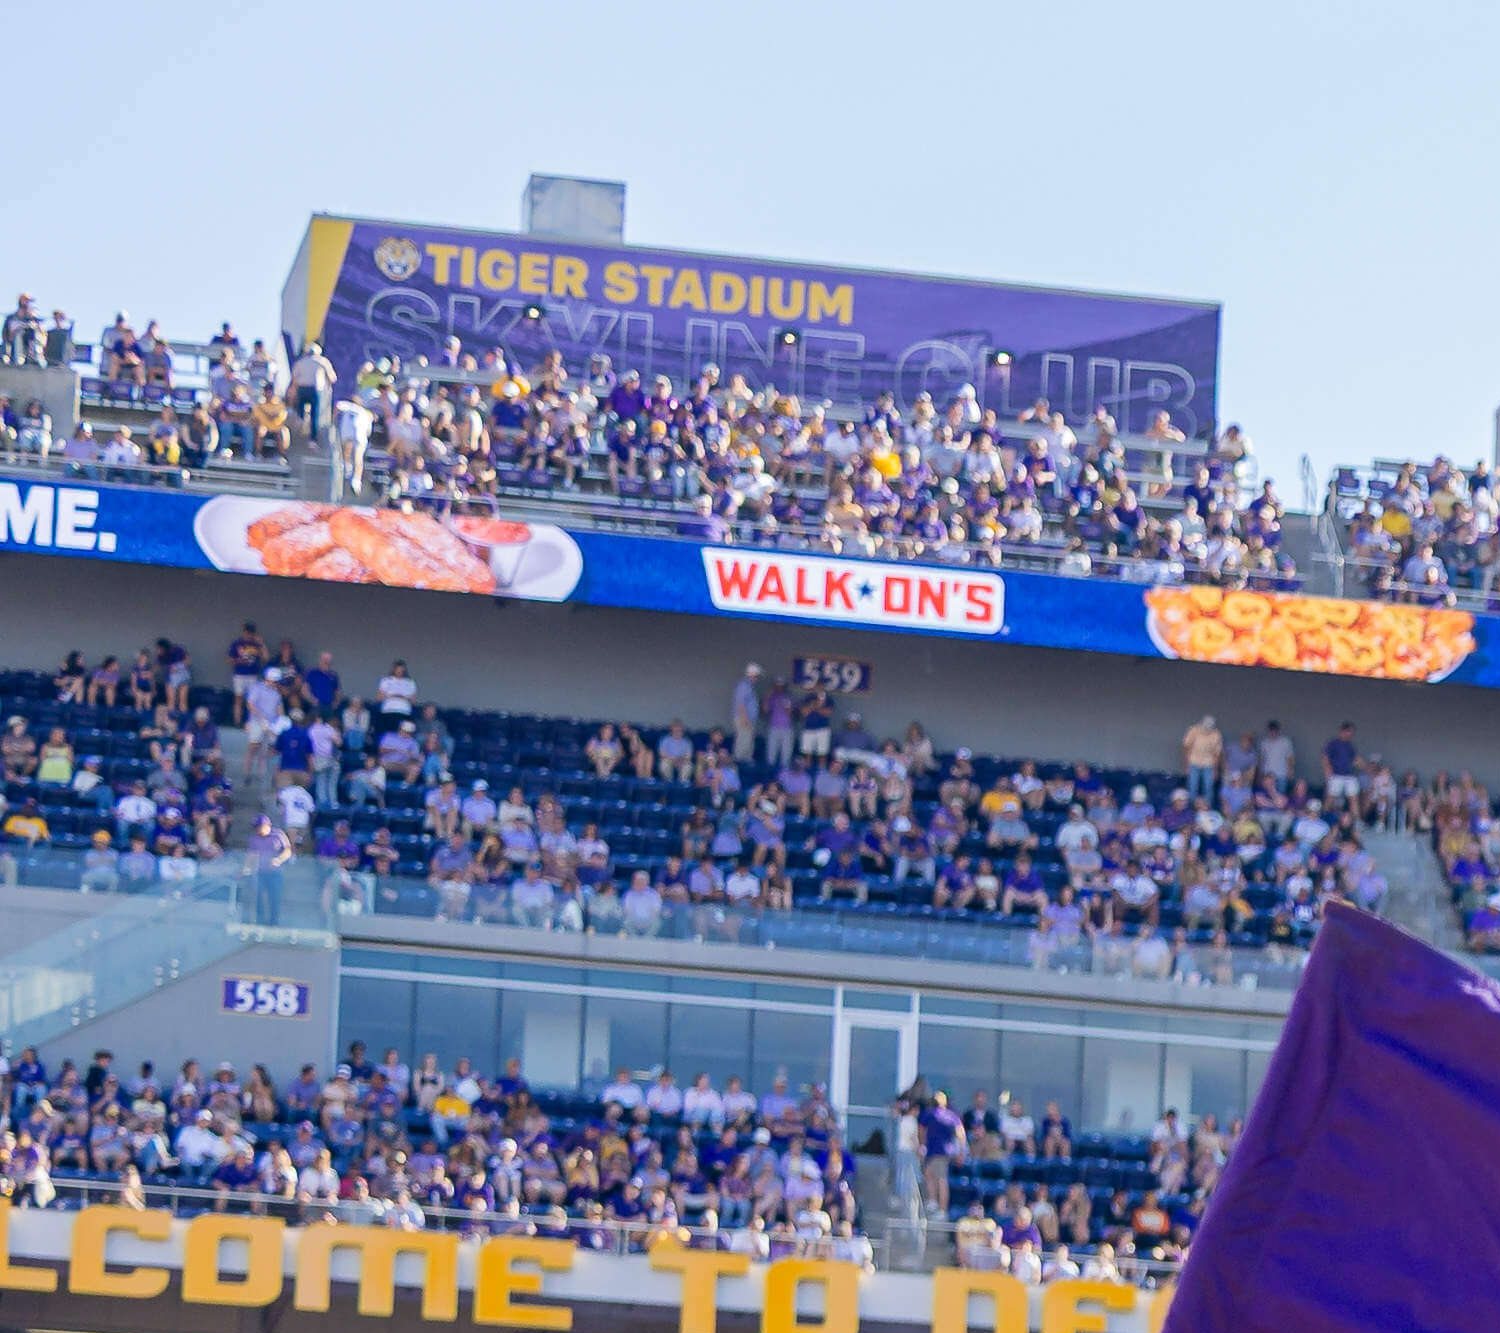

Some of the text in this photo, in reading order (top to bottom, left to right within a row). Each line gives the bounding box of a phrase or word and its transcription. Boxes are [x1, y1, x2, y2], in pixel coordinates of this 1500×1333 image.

[426, 243, 855, 326] TIGER STADIUM
[0, 482, 117, 550] ME.
[803, 660, 863, 692] 559
[231, 982, 298, 1016] 558
